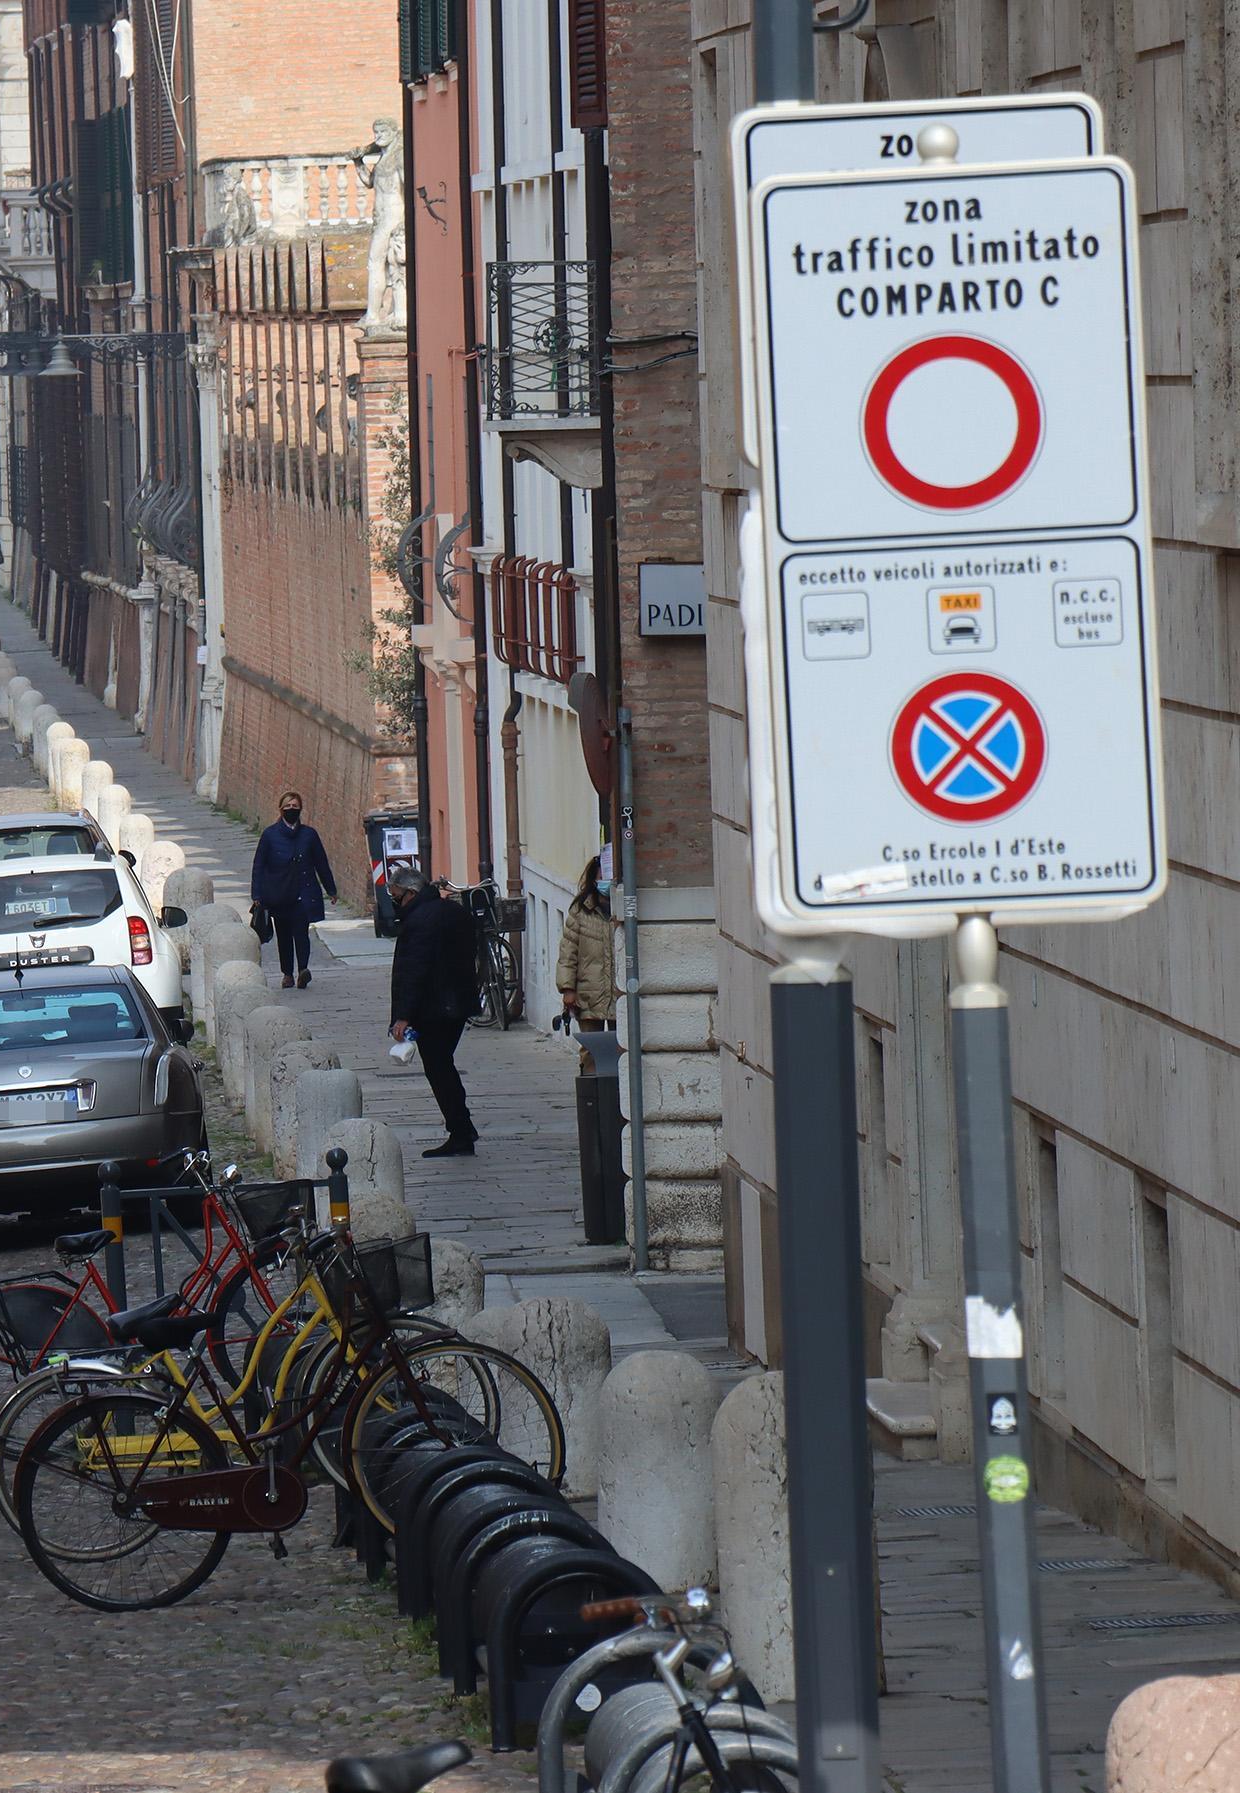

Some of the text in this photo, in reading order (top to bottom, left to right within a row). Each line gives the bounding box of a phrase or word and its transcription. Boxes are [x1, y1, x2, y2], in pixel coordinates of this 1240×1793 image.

[880, 135, 915, 158] zo
[905, 197, 983, 224] zona
[792, 227, 1100, 275] traffico limitato
[836, 275, 1059, 319] COMPARTO C
[798, 559, 1068, 585] eccetto veicoli autorizzati e:
[943, 595, 979, 610] TAXI
[1059, 589, 1116, 604] n.c.c.
[1063, 612, 1113, 626] escluso
[1077, 627, 1100, 640] bus
[882, 845, 921, 862] C.so
[929, 841, 987, 860] Ercole
[1010, 838, 1066, 856] d'Este
[910, 868, 966, 887] stello
[973, 872, 982, 884] a
[990, 866, 1029, 884] C.so
[1037, 863, 1055, 881] B.
[1061, 860, 1138, 880] Rossetti
[9, 955, 70, 967] DUSTER
